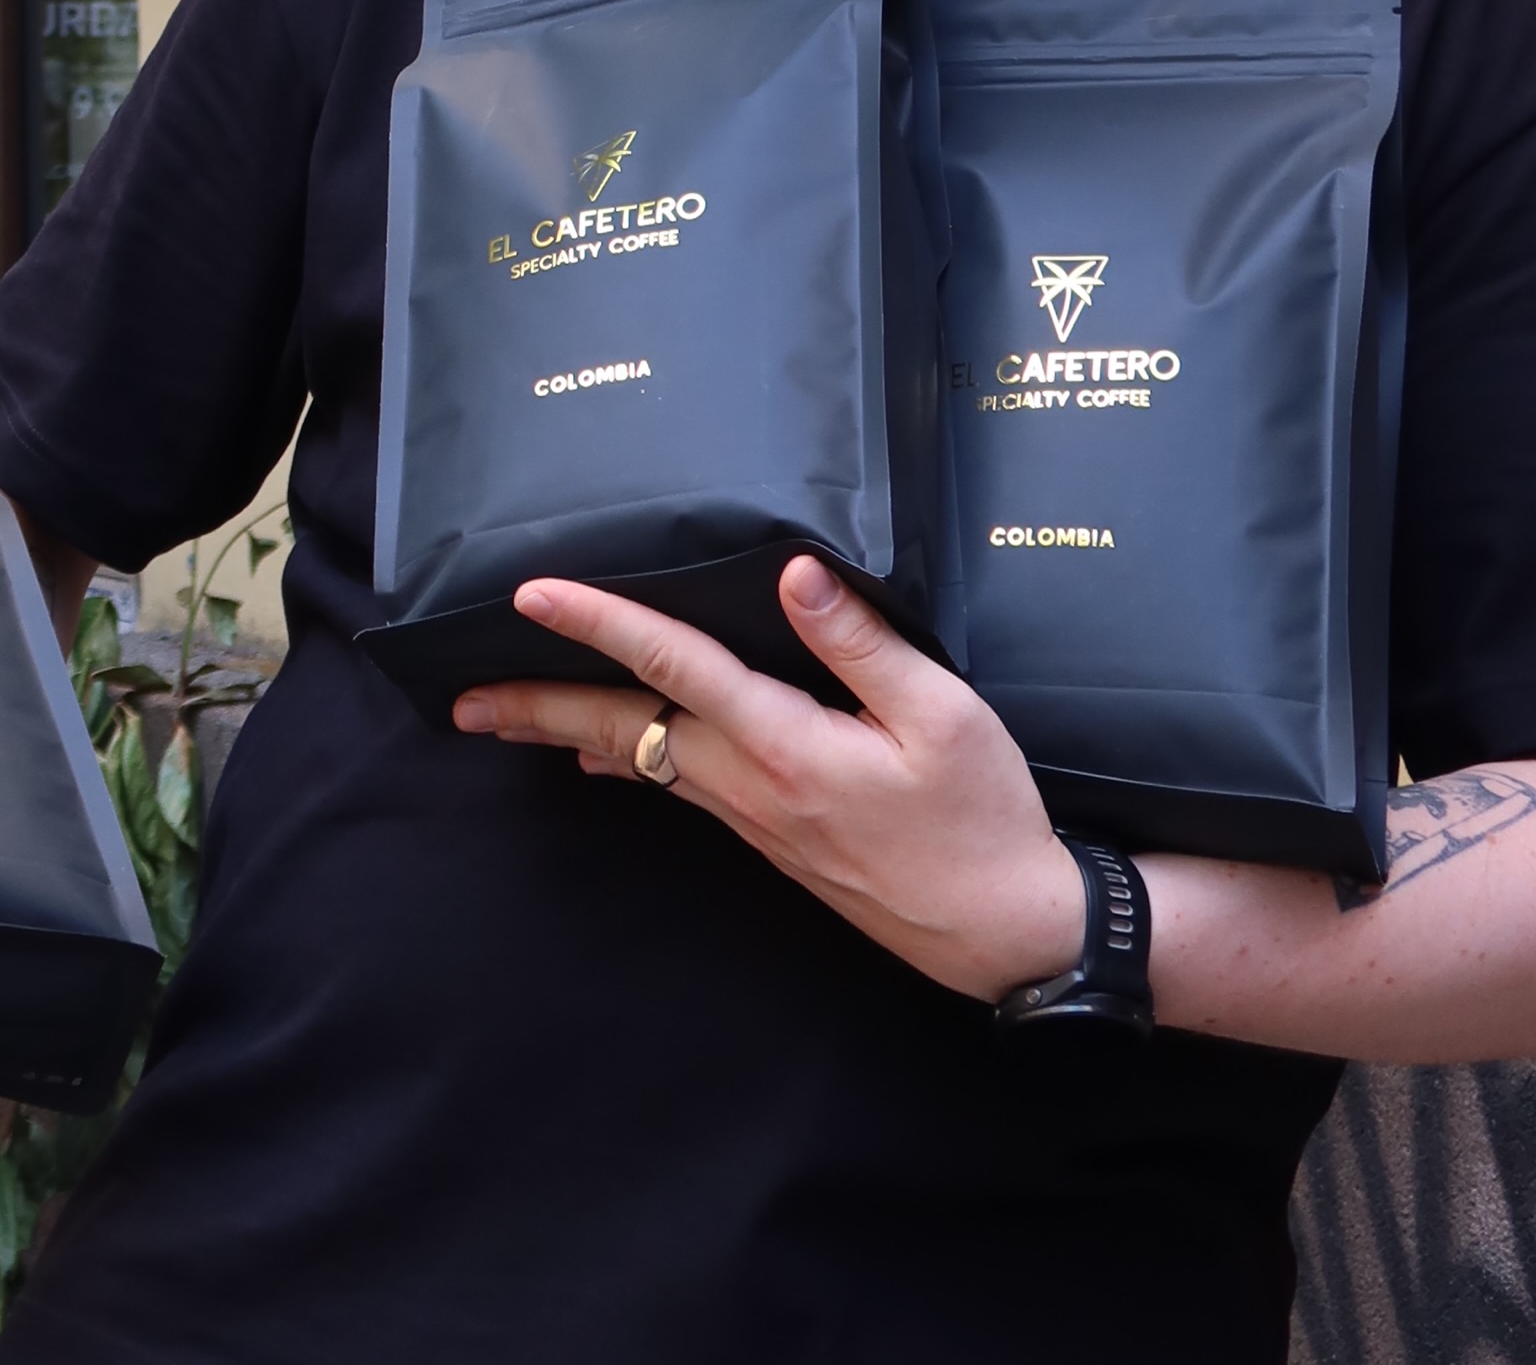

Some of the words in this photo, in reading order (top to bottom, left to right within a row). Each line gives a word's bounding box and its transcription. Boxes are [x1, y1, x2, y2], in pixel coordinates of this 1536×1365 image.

[488, 234, 518, 264] EL
[531, 192, 707, 248] CAFETERO
[510, 241, 602, 279] SPECIALTY
[608, 229, 679, 254] COFFEE
[533, 360, 651, 397] COLOMBIA
[996, 350, 1181, 384] CAFETERO
[1076, 390, 1151, 408] COFFEE
[989, 525, 1116, 550] COLOMBIA
